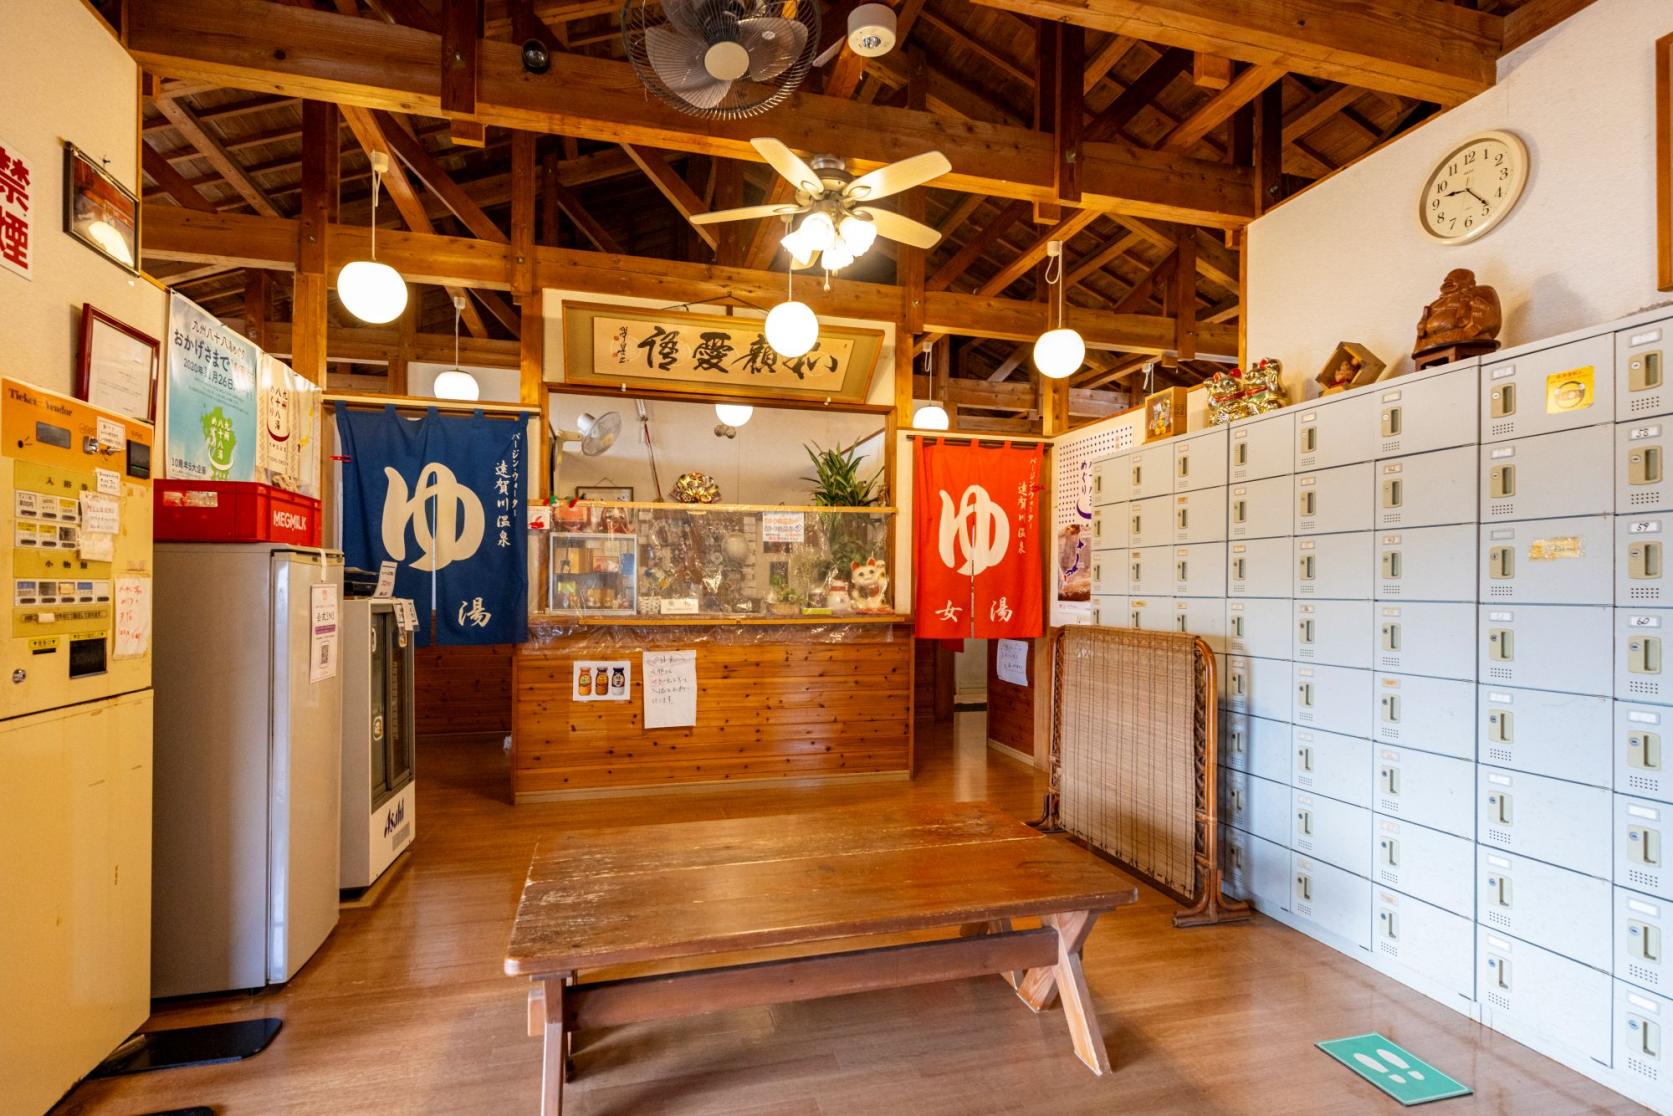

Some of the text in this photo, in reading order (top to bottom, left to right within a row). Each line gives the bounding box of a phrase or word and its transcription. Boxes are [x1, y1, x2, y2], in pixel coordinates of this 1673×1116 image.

[1463, 151, 1476, 165] 12
[1483, 148, 1489, 160] 1
[1494, 153, 1504, 167] 2
[1448, 163, 1458, 176] 11
[1499, 167, 1509, 181] 3
[1436, 180, 1448, 194] 10
[1494, 186, 1502, 198] 4
[1432, 198, 1440, 211] 9
[1481, 206, 1490, 217] 5
[1436, 211, 1445, 224] 8
[1448, 217, 1457, 231] 7
[1464, 215, 1473, 228] 6
[494, 460, 511, 548] 遠賀川温泉
[273, 510, 307, 530] MEGMILK
[381, 462, 486, 572] ゆ
[939, 484, 1010, 576] ゆ
[1636, 522, 1650, 531] 59
[458, 596, 493, 628] 湯
[384, 798, 404, 838] Asahi
